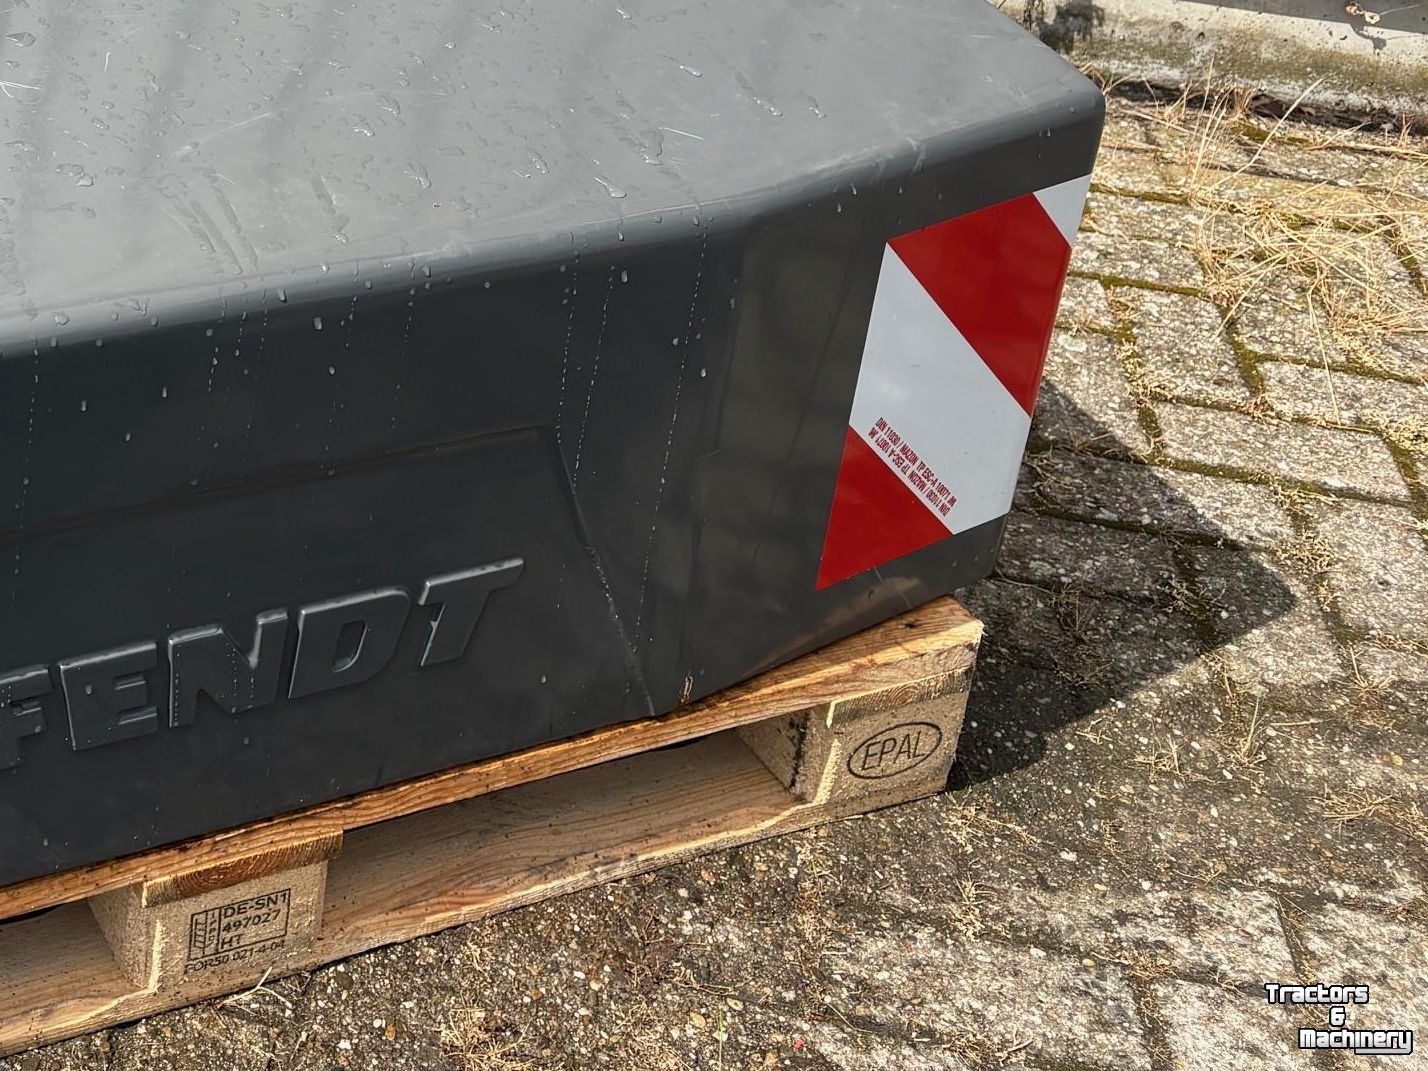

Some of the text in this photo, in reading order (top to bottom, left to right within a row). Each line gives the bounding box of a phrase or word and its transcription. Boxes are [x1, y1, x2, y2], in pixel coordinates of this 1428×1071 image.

[876, 416, 889, 432] DIN
[884, 427, 901, 446] 11030
[899, 443, 920, 466] MAZON
[917, 461, 927, 473] TP
[922, 467, 939, 488] ESC-A
[936, 482, 951, 500] 10071
[901, 463, 910, 475] TP
[908, 470, 927, 492] MAZON
[939, 502, 951, 517] DIN
[861, 731, 926, 771] EPAL
[223, 892, 288, 919] DE-SN1
[222, 909, 281, 933] 497027
[220, 933, 245, 950] HT
